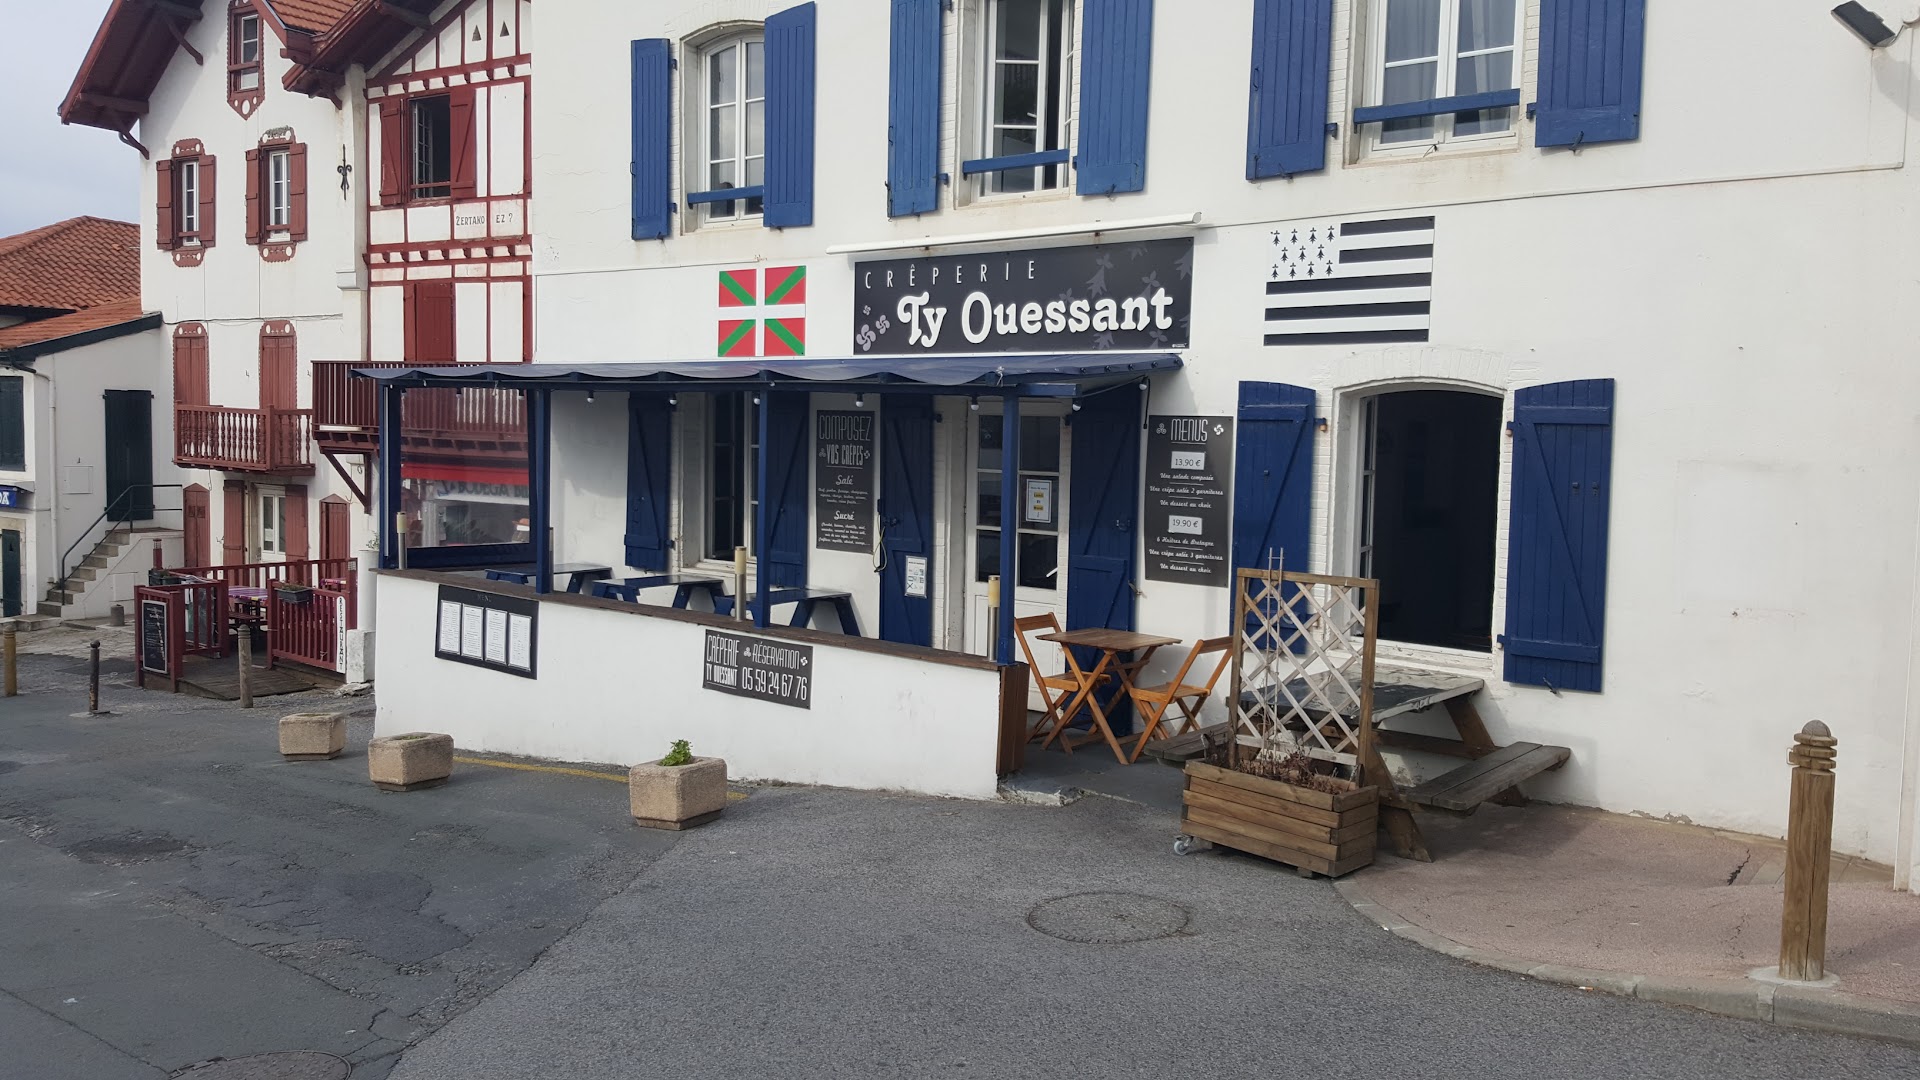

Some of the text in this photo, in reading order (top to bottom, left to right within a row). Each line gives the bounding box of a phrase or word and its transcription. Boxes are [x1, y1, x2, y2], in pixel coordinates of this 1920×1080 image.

[496, 214, 506, 224] EZ
[864, 260, 1035, 289] CRÊPERIE
[897, 288, 1174, 348] Ty Ouessant
[819, 415, 872, 441] COMPOSEZ
[1170, 418, 1208, 442] MENUS
[826, 444, 839, 464] VOS
[836, 474, 854, 486] Salé
[834, 510, 854, 520] Sucré
[752, 641, 800, 670] RÉSERVATION
[706, 663, 738, 686] TY OUESSANT
[742, 666, 808, 700] 05 59 24 67 76
